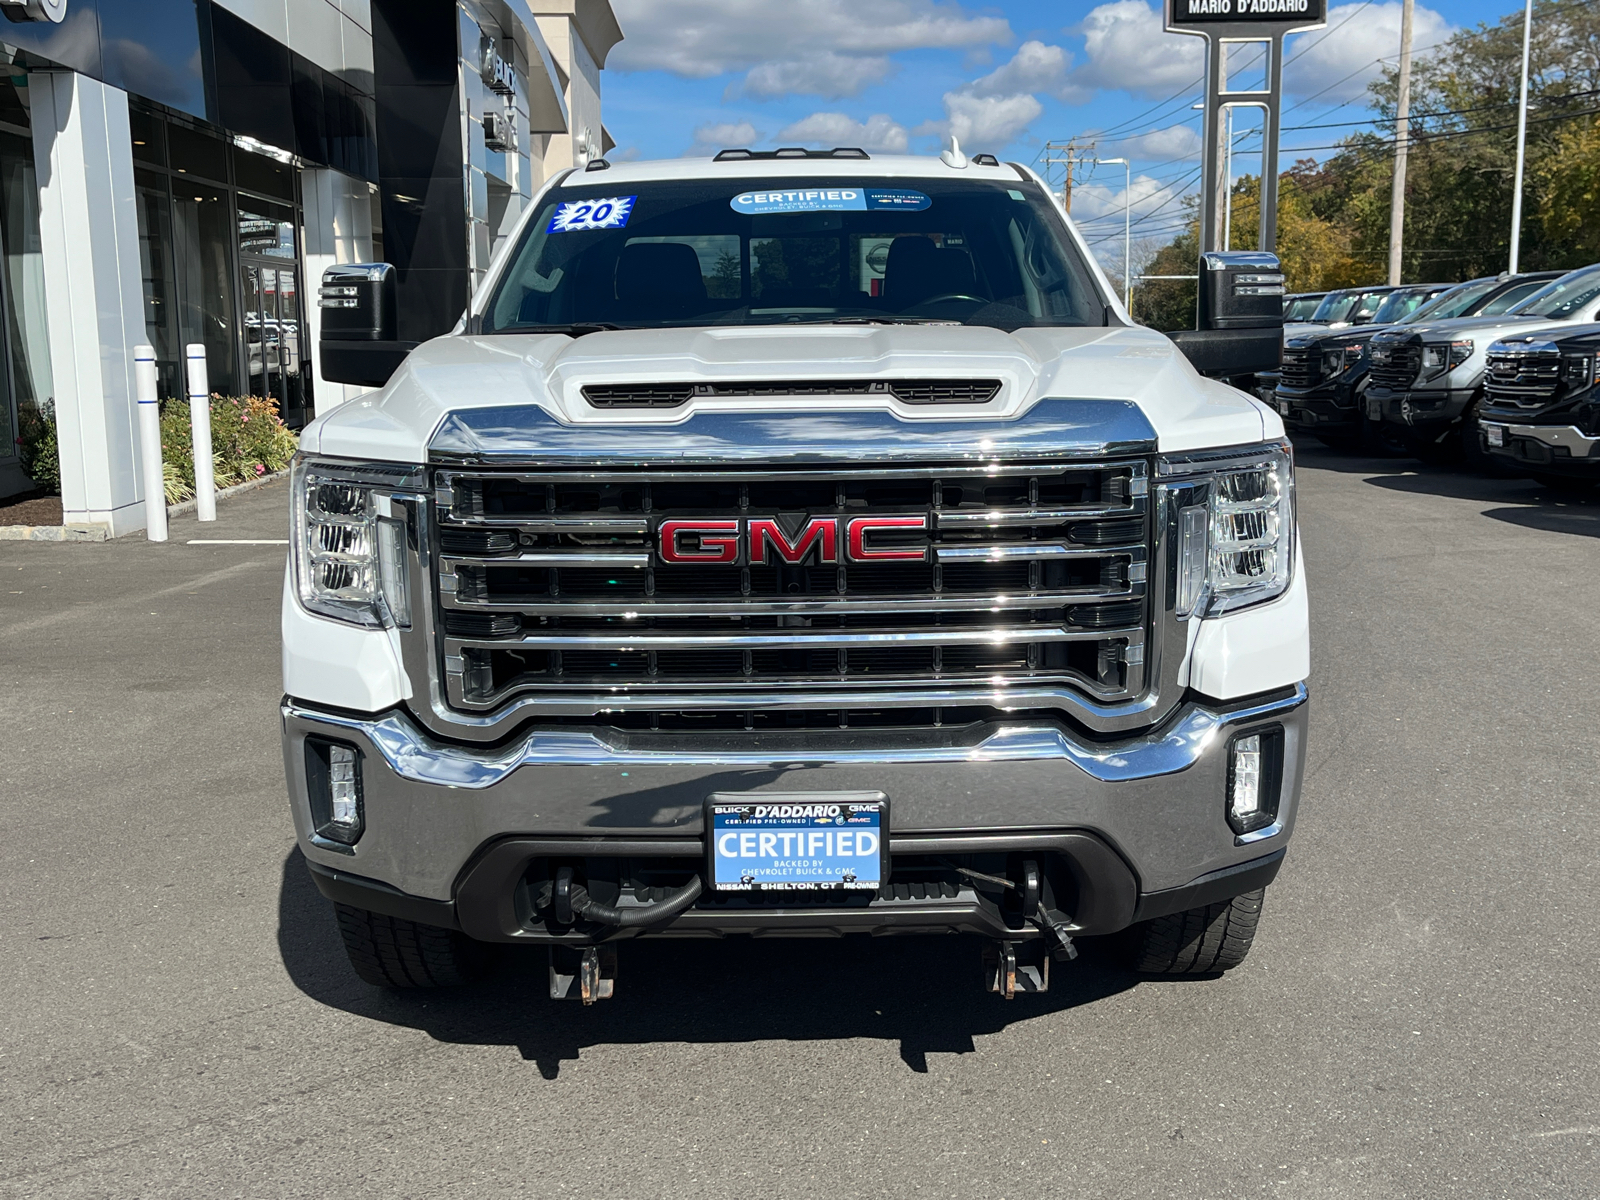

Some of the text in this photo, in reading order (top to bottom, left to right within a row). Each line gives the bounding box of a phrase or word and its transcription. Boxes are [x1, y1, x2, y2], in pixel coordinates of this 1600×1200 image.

[1188, 0, 1308, 14] MARIO D'ADDARIO
[737, 191, 857, 205] CERTIFIED
[568, 203, 613, 224] 20
[658, 516, 929, 564] GMC
[714, 806, 750, 814] BUICK
[754, 805, 841, 818] D'ADDARIO
[718, 831, 878, 858] CERTIFIED
[773, 859, 823, 868] BACKED BY
[741, 867, 856, 876] CHEVROLET BUICK & GMC
[716, 882, 880, 891] NISSAN SHELTON, CT PRE-OWNED
